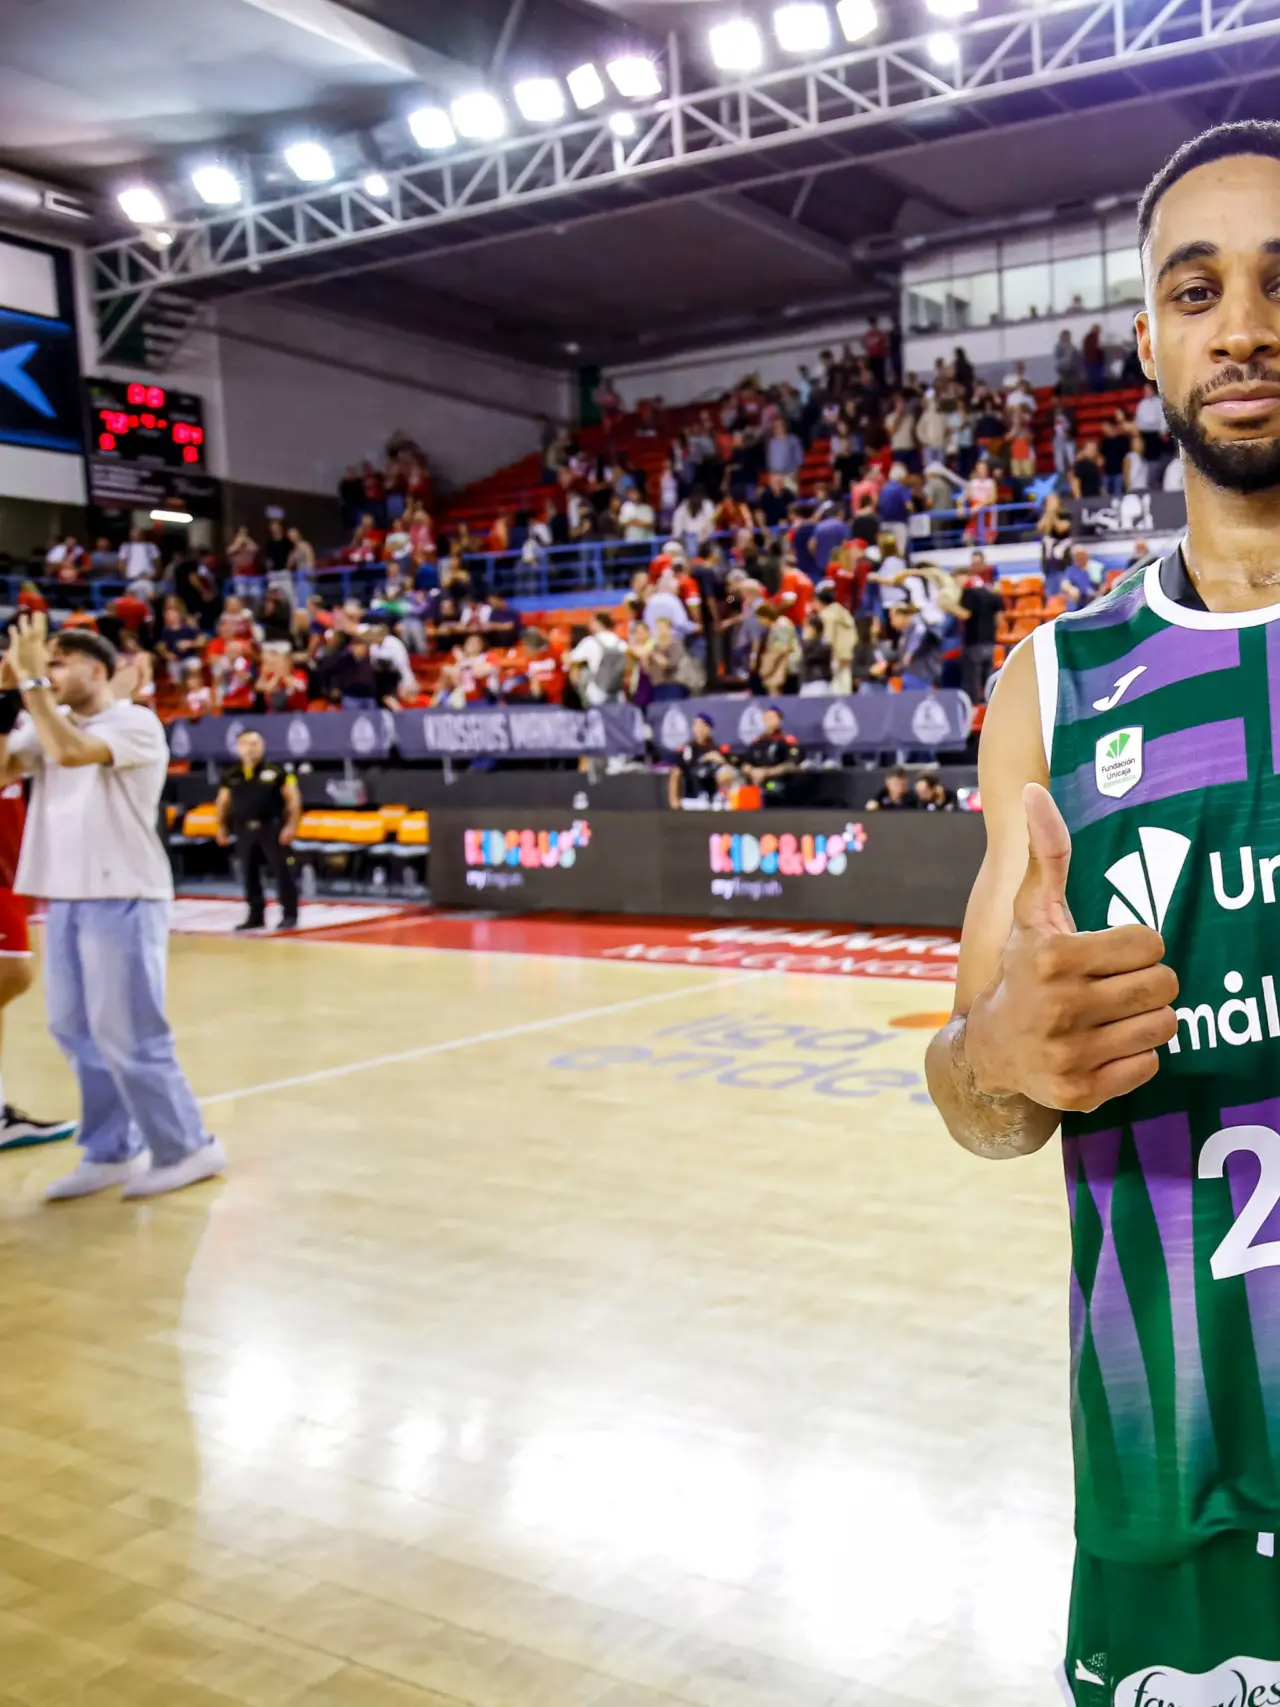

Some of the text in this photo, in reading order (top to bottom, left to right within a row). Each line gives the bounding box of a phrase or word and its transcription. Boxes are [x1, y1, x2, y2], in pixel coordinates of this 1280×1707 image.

[1101, 757, 1136, 773] Fundación
[1106, 767, 1132, 780] Unicaja
[709, 833, 848, 876] KIDS&US
